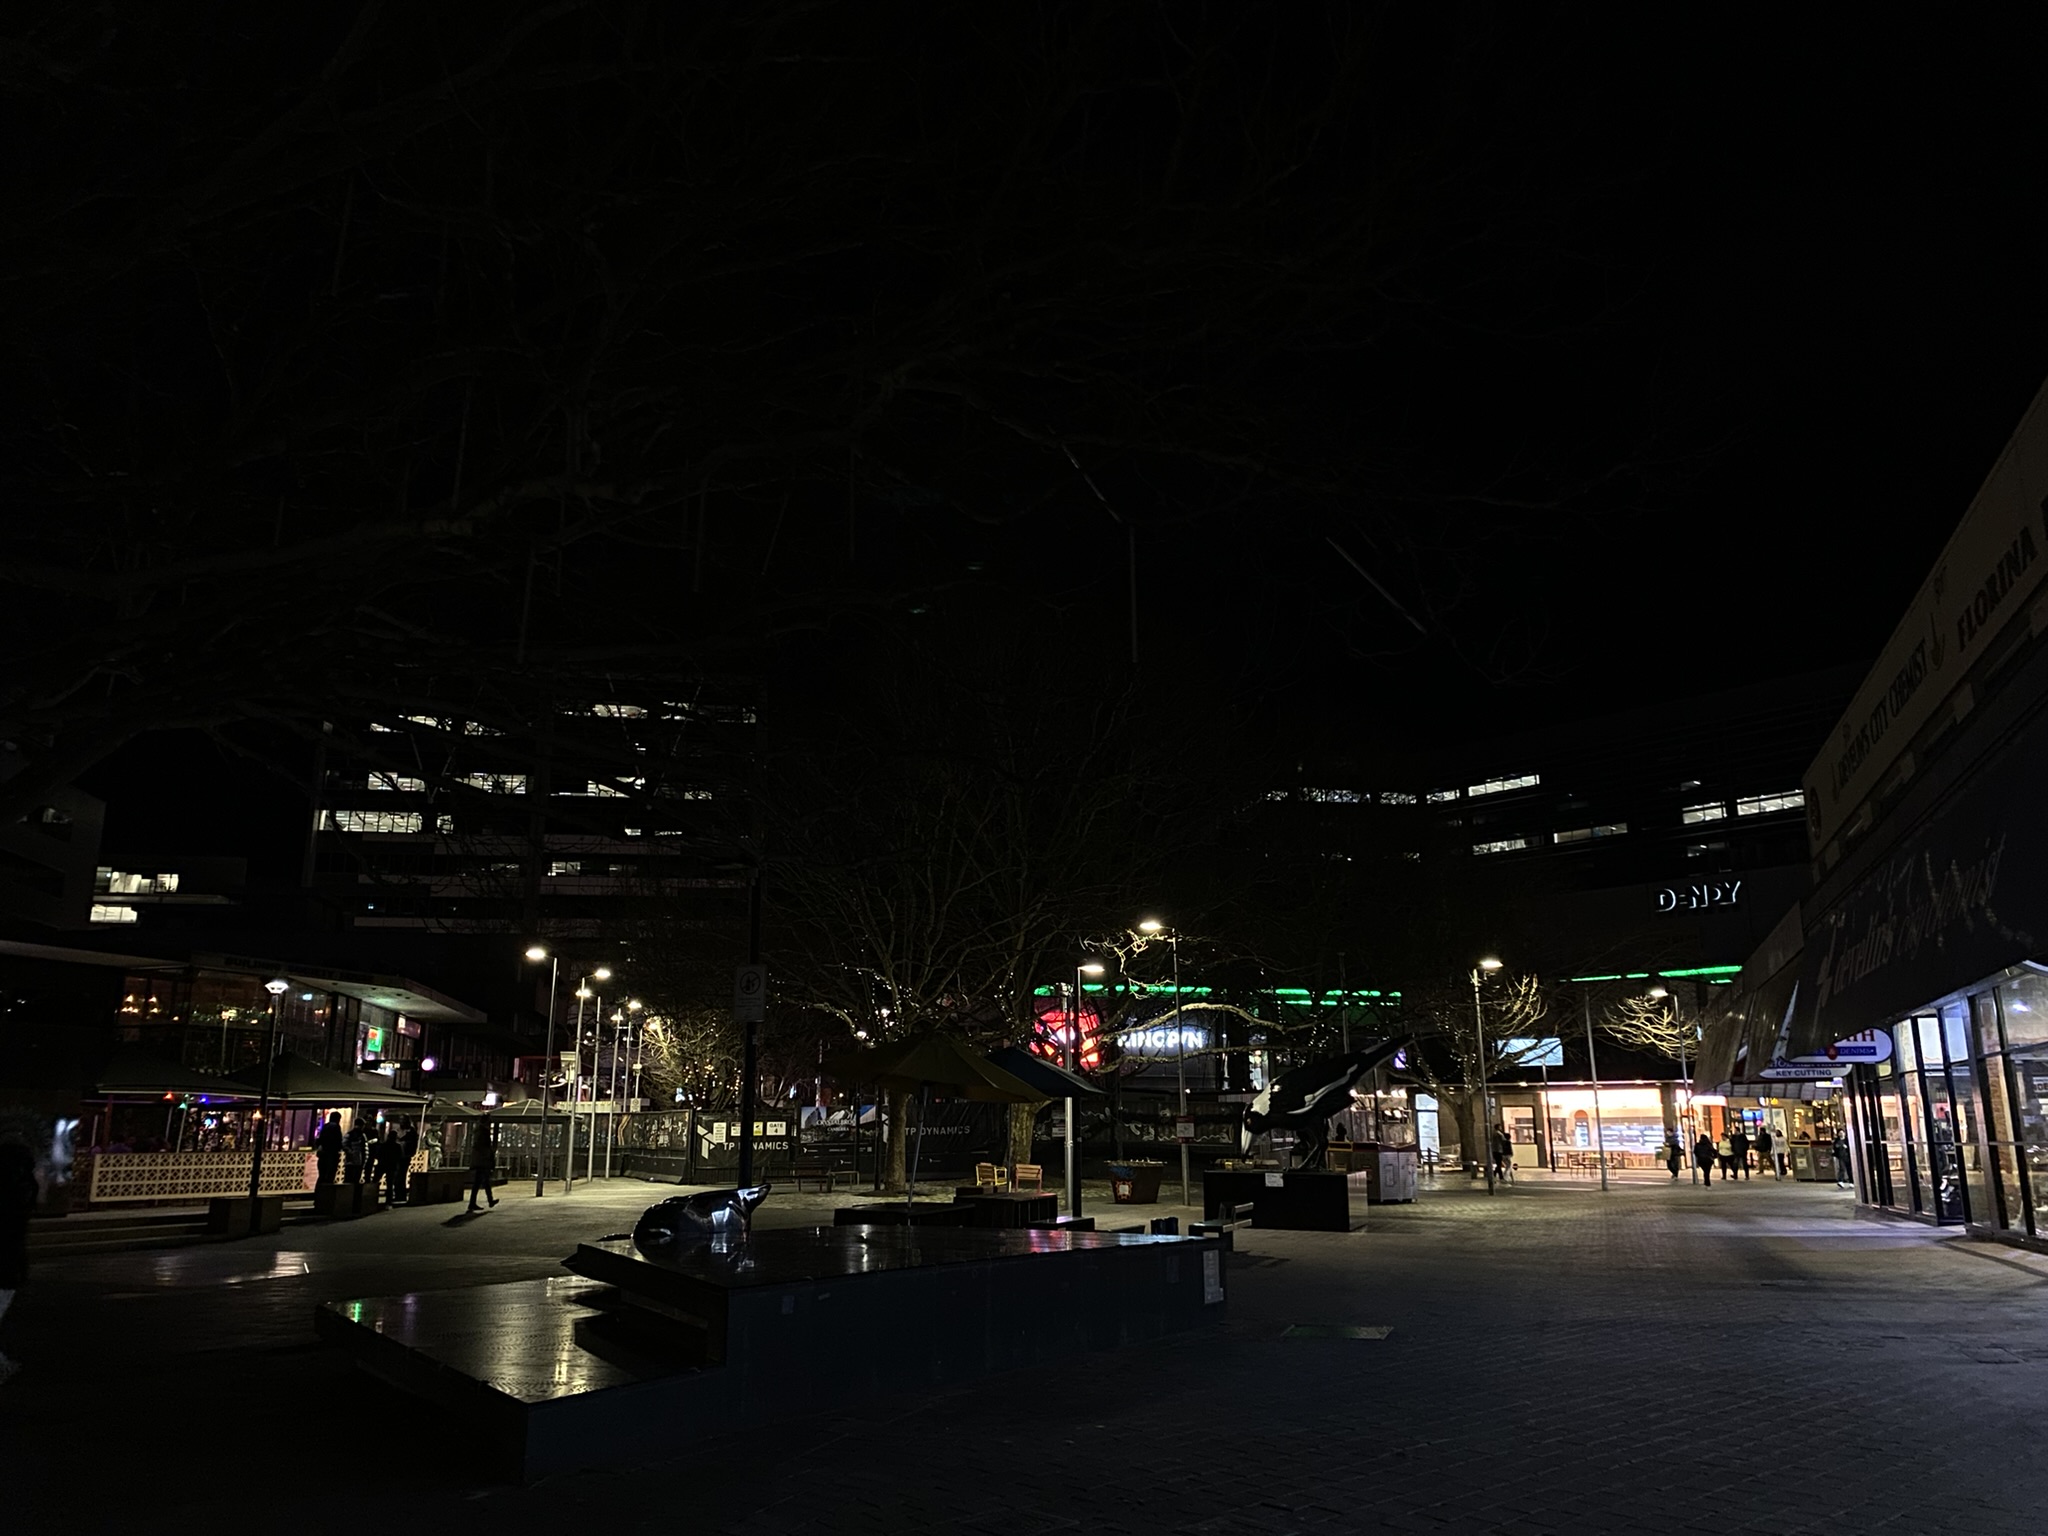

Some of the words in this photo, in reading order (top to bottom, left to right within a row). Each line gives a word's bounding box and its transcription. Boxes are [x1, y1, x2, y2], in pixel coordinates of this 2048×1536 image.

[1956, 526, 2038, 653] FLORINA
[1655, 880, 1742, 913] DENDY
[1776, 1069, 1792, 1077] KEY
[1794, 1069, 1832, 1077] CUTTING
[904, 1127, 917, 1136] TP
[723, 1141, 735, 1151] TP
